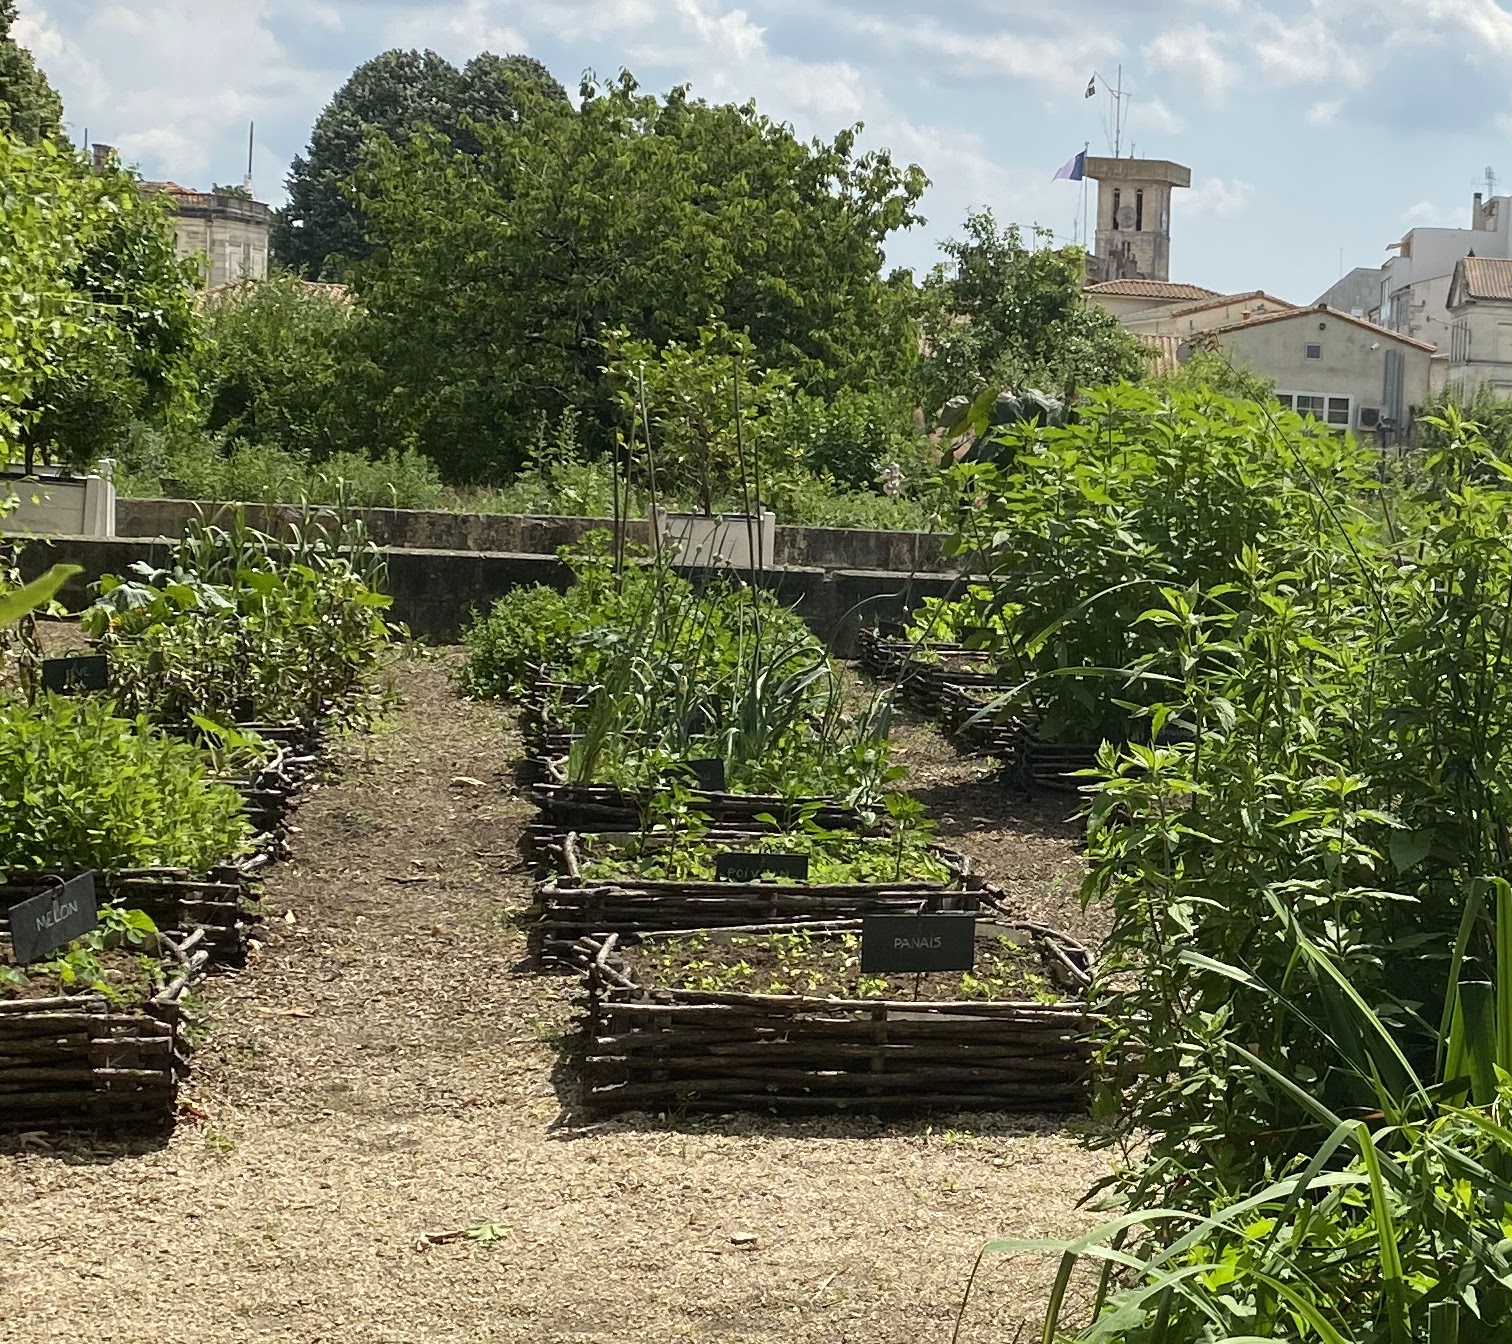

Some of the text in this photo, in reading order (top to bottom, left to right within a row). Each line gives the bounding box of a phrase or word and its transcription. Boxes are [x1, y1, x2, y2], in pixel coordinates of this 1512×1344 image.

[726, 867, 790, 879] POIVN
[35, 899, 79, 932] MELON
[893, 936, 942, 950] PANAIS
